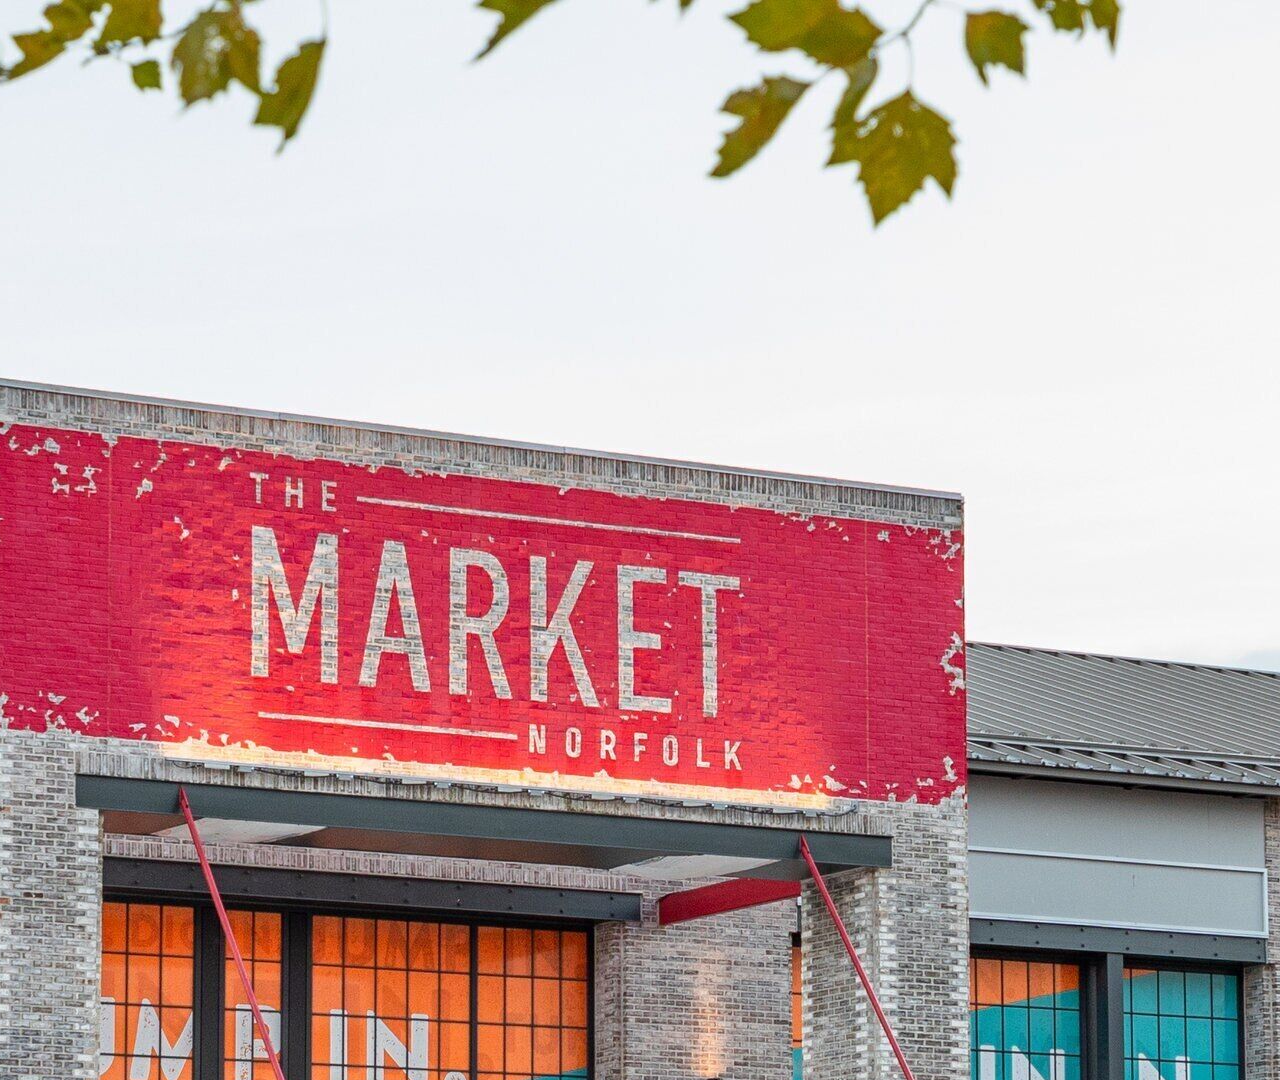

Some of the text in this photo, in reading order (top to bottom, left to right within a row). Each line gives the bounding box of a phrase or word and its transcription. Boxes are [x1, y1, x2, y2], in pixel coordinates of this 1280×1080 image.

[250, 473, 337, 512] THE
[250, 525, 741, 718] MARKET
[528, 723, 743, 771] NORFOLK
